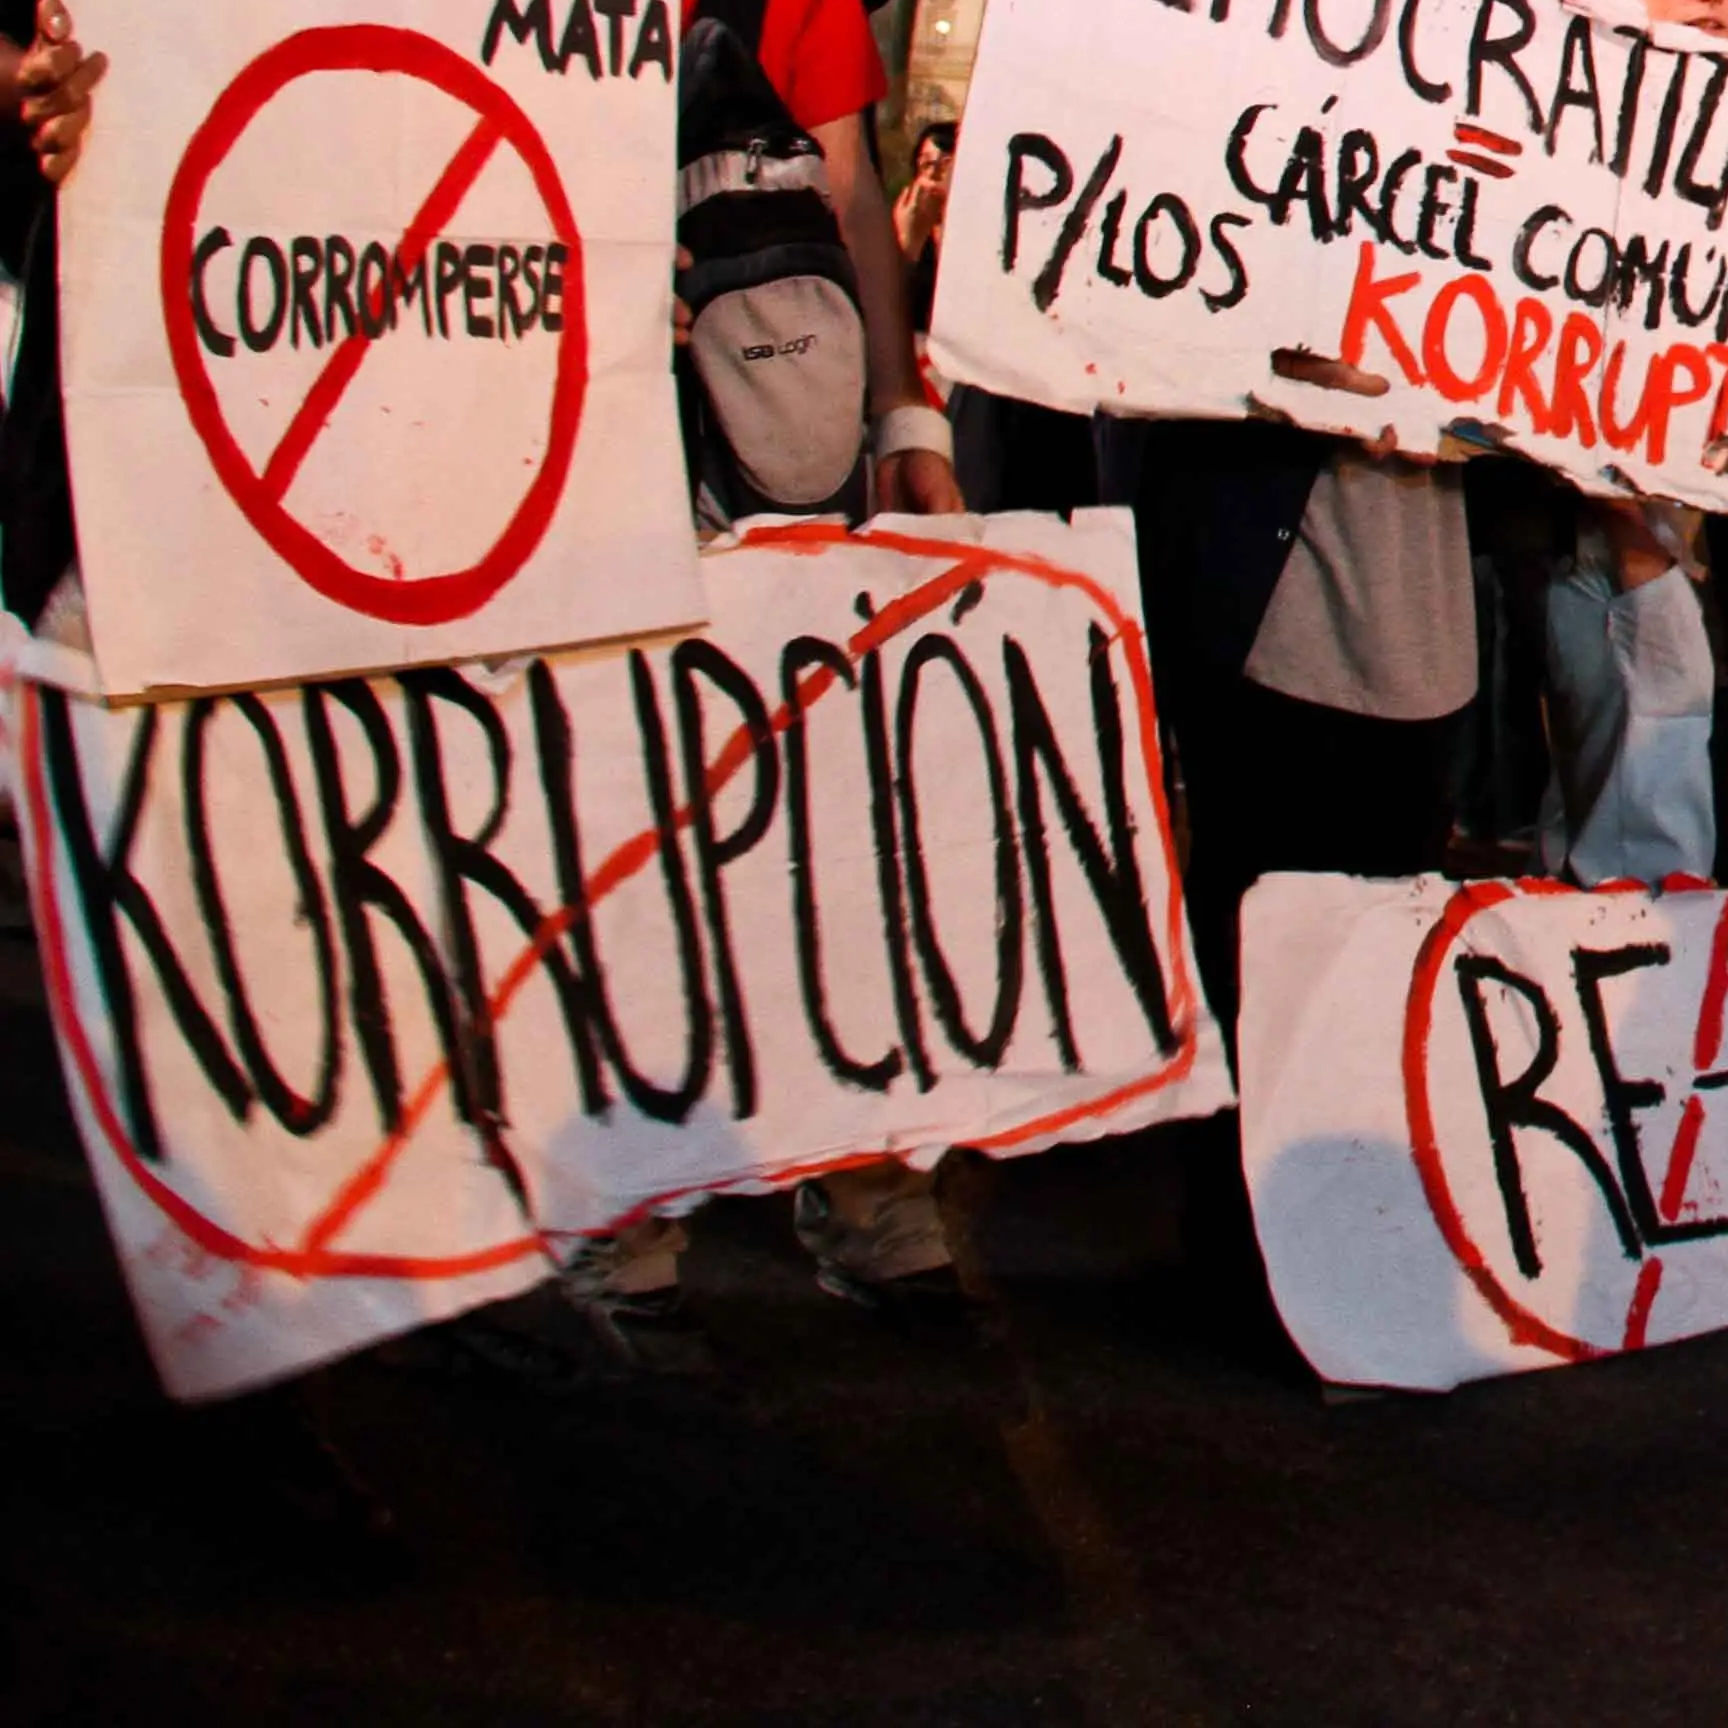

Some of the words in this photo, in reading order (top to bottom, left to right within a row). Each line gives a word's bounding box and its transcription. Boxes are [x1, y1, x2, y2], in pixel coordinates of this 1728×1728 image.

[1002, 130, 1256, 315] P/LOS
[1226, 95, 1494, 271] CÁRCEL
[188, 224, 570, 358] CORROMPERSE
[40, 576, 1187, 1167] KORRUPCIÓN
